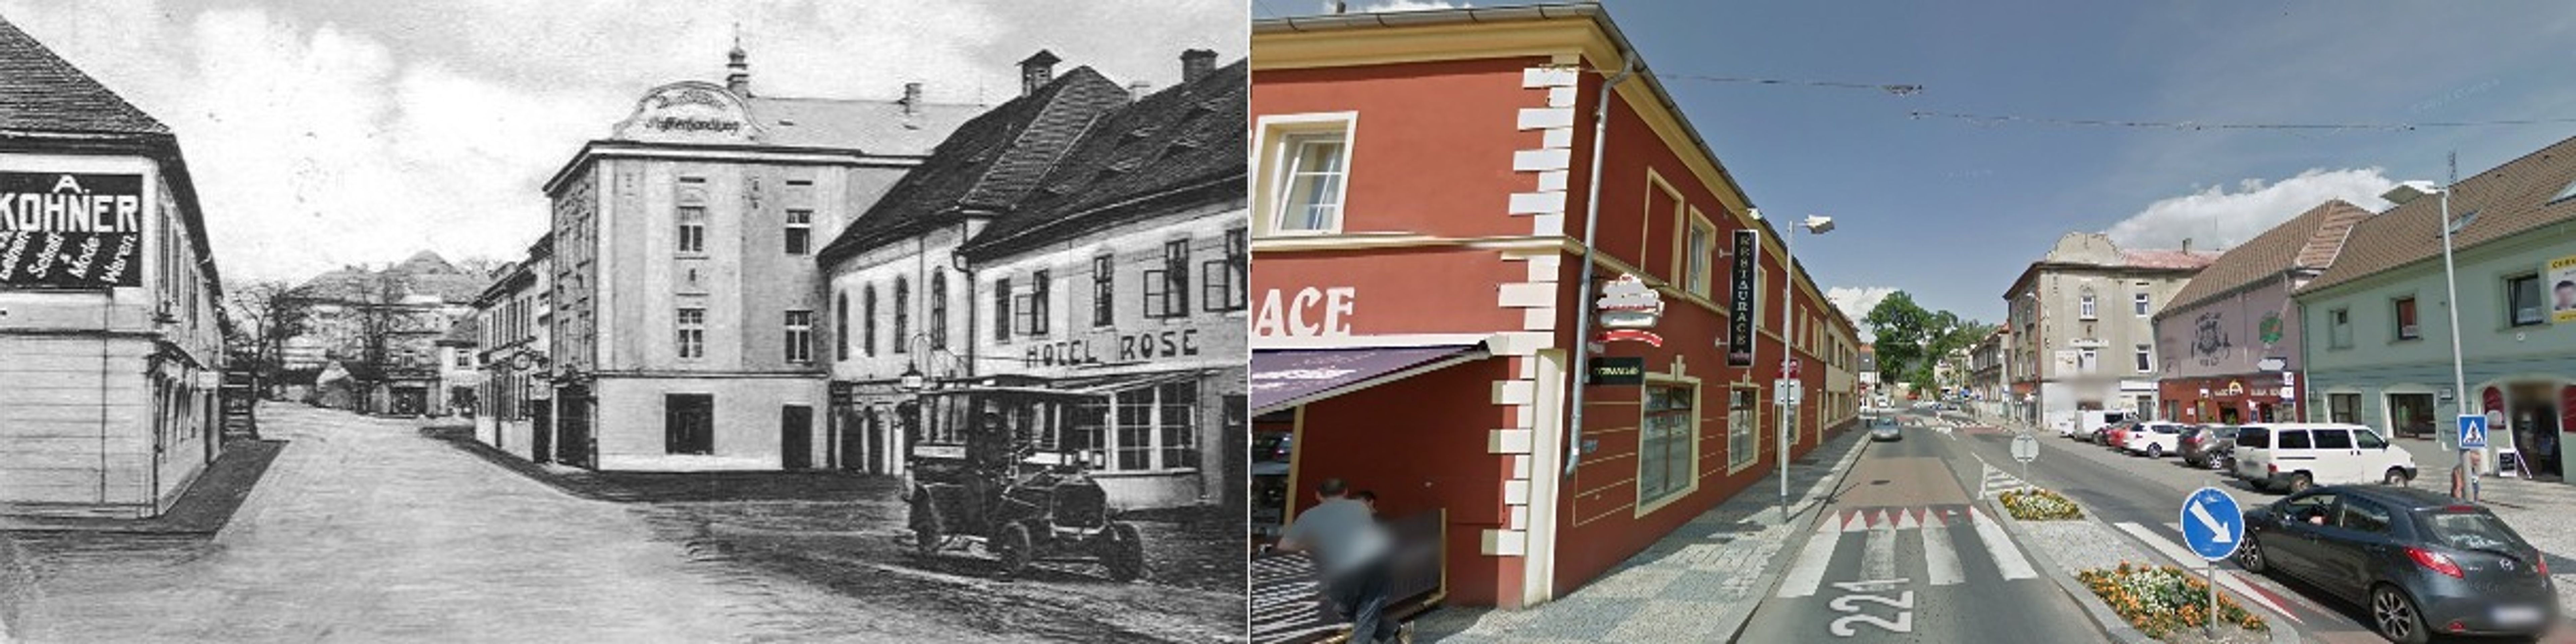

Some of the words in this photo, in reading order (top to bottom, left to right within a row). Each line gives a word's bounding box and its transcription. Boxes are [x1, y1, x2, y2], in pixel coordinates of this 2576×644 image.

[68, 235, 100, 280] Mode
[100, 234, 137, 283] Waren
[1735, 235, 1751, 345] RESTAURACE
[1027, 339, 1097, 368] HOTEL
[1120, 329, 1197, 361] ROSE
